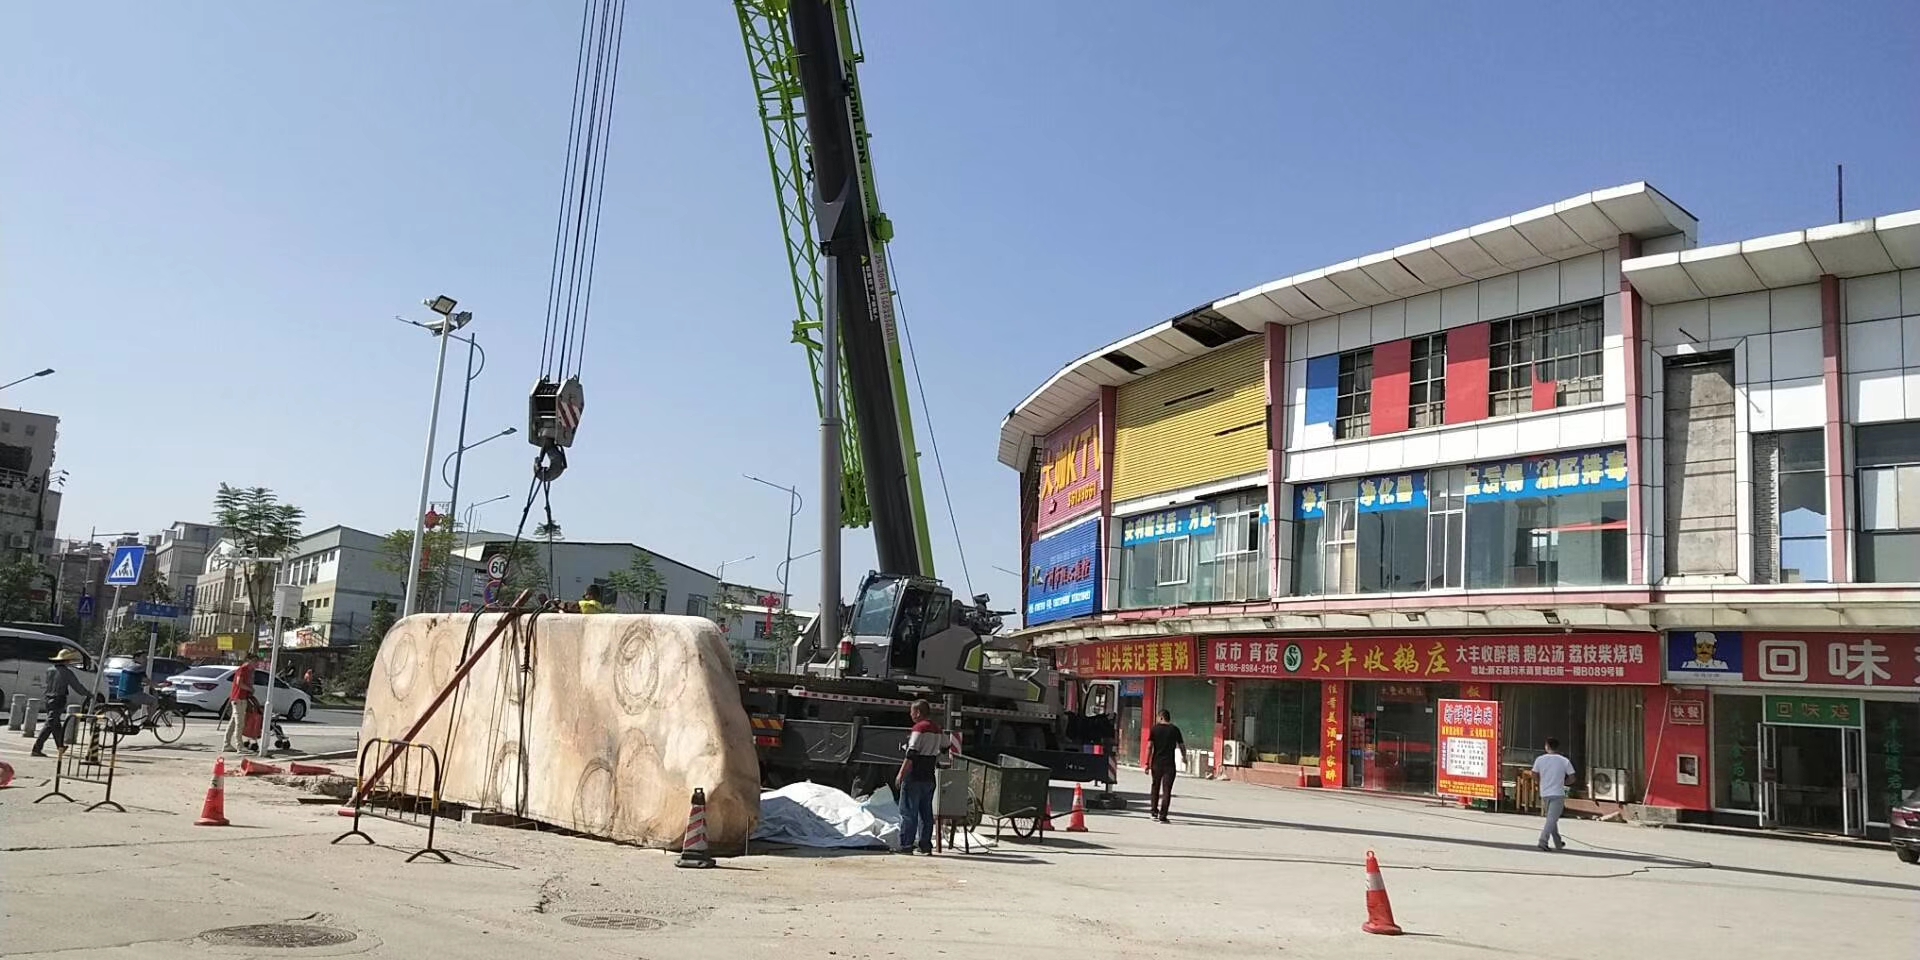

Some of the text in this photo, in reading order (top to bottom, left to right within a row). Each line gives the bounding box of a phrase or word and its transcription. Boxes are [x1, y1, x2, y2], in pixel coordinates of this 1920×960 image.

[843, 59, 867, 164] ZOOMLION
[491, 561, 506, 574] 60
[1215, 642, 1279, 662] 饭市 宵夜
[1312, 641, 1451, 677] 大丰收鹅庄
[1456, 644, 1644, 664] 大丰收醉鹅 鹅公汤 荔枝柴烧鸡
[1758, 638, 1920, 686] 回味
[1672, 705, 1700, 718] 快餐
